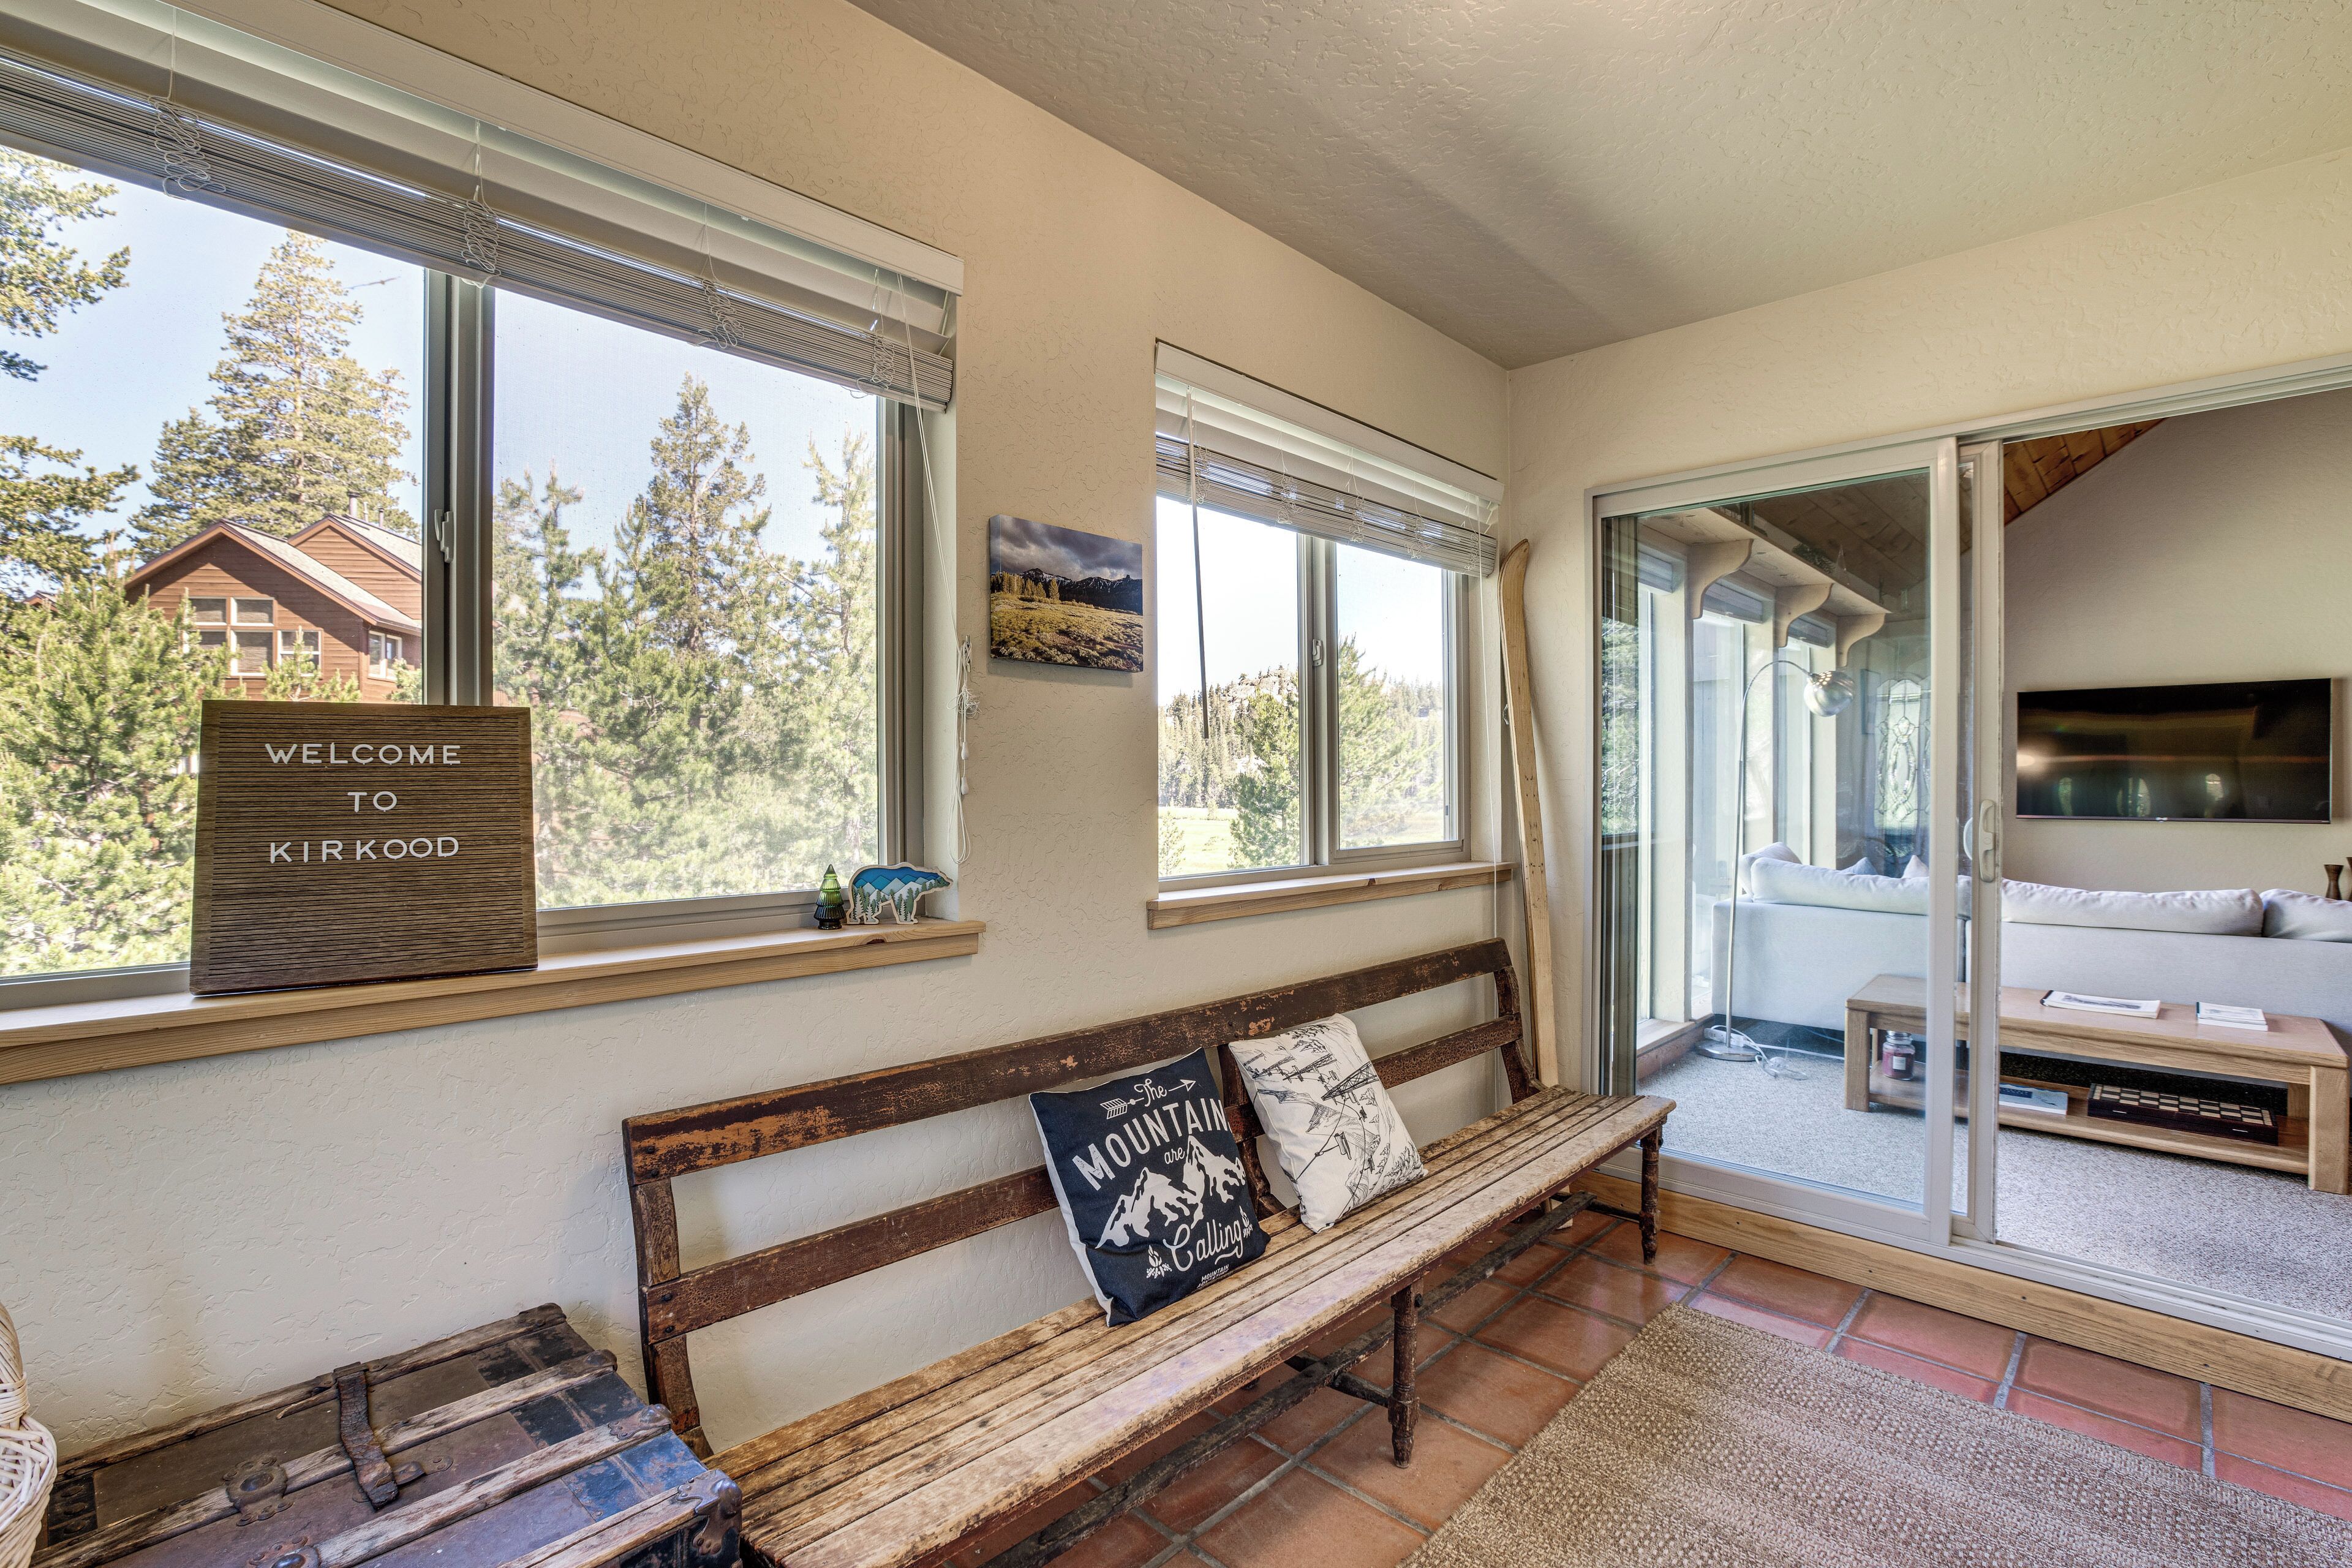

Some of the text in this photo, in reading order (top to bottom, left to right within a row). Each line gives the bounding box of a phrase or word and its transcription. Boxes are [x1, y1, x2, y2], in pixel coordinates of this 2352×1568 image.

[265, 742, 461, 764] WELCOME
[347, 791, 398, 812] TO
[270, 837, 459, 863] KIRKOOD
[1134, 1078, 1167, 1107] The
[1072, 1098, 1233, 1191] MOUNTAIN
[1164, 1148, 1185, 1166] are
[1163, 1219, 1243, 1272] Calling
[1201, 1264, 1229, 1282] MOUNTAIN
